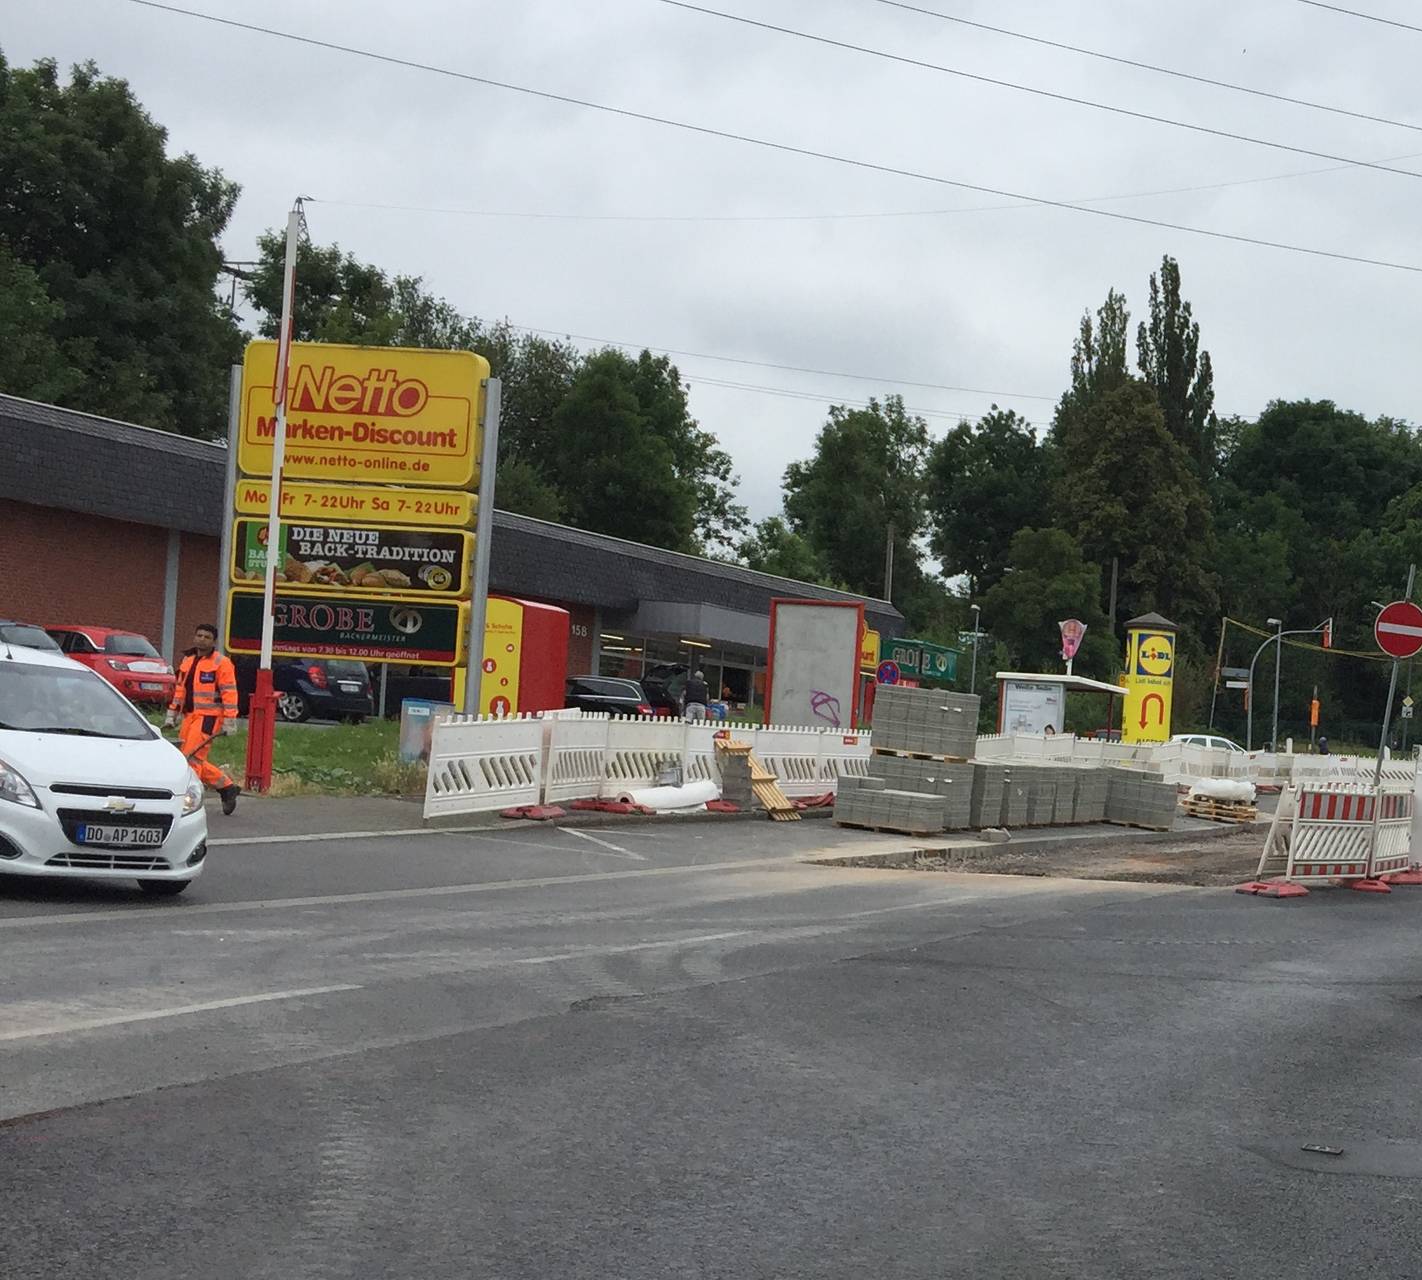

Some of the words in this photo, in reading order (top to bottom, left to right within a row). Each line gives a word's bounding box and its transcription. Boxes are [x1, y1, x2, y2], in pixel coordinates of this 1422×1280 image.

[290, 364, 428, 418] Netto
[256, 416, 457, 448] Mrken-Discount
[244, 489, 268, 504] Mo
[282, 492, 296, 505] Fr
[371, 496, 390, 511] Sa
[291, 526, 324, 542] DIE
[328, 529, 379, 545] NEUE
[299, 542, 456, 564] BACK-TRADITION
[571, 624, 588, 637] 158
[370, 649, 385, 657] Uhr
[87, 827, 104, 841] DO
[112, 828, 128, 842] AP
[131, 830, 161, 843] 1603
